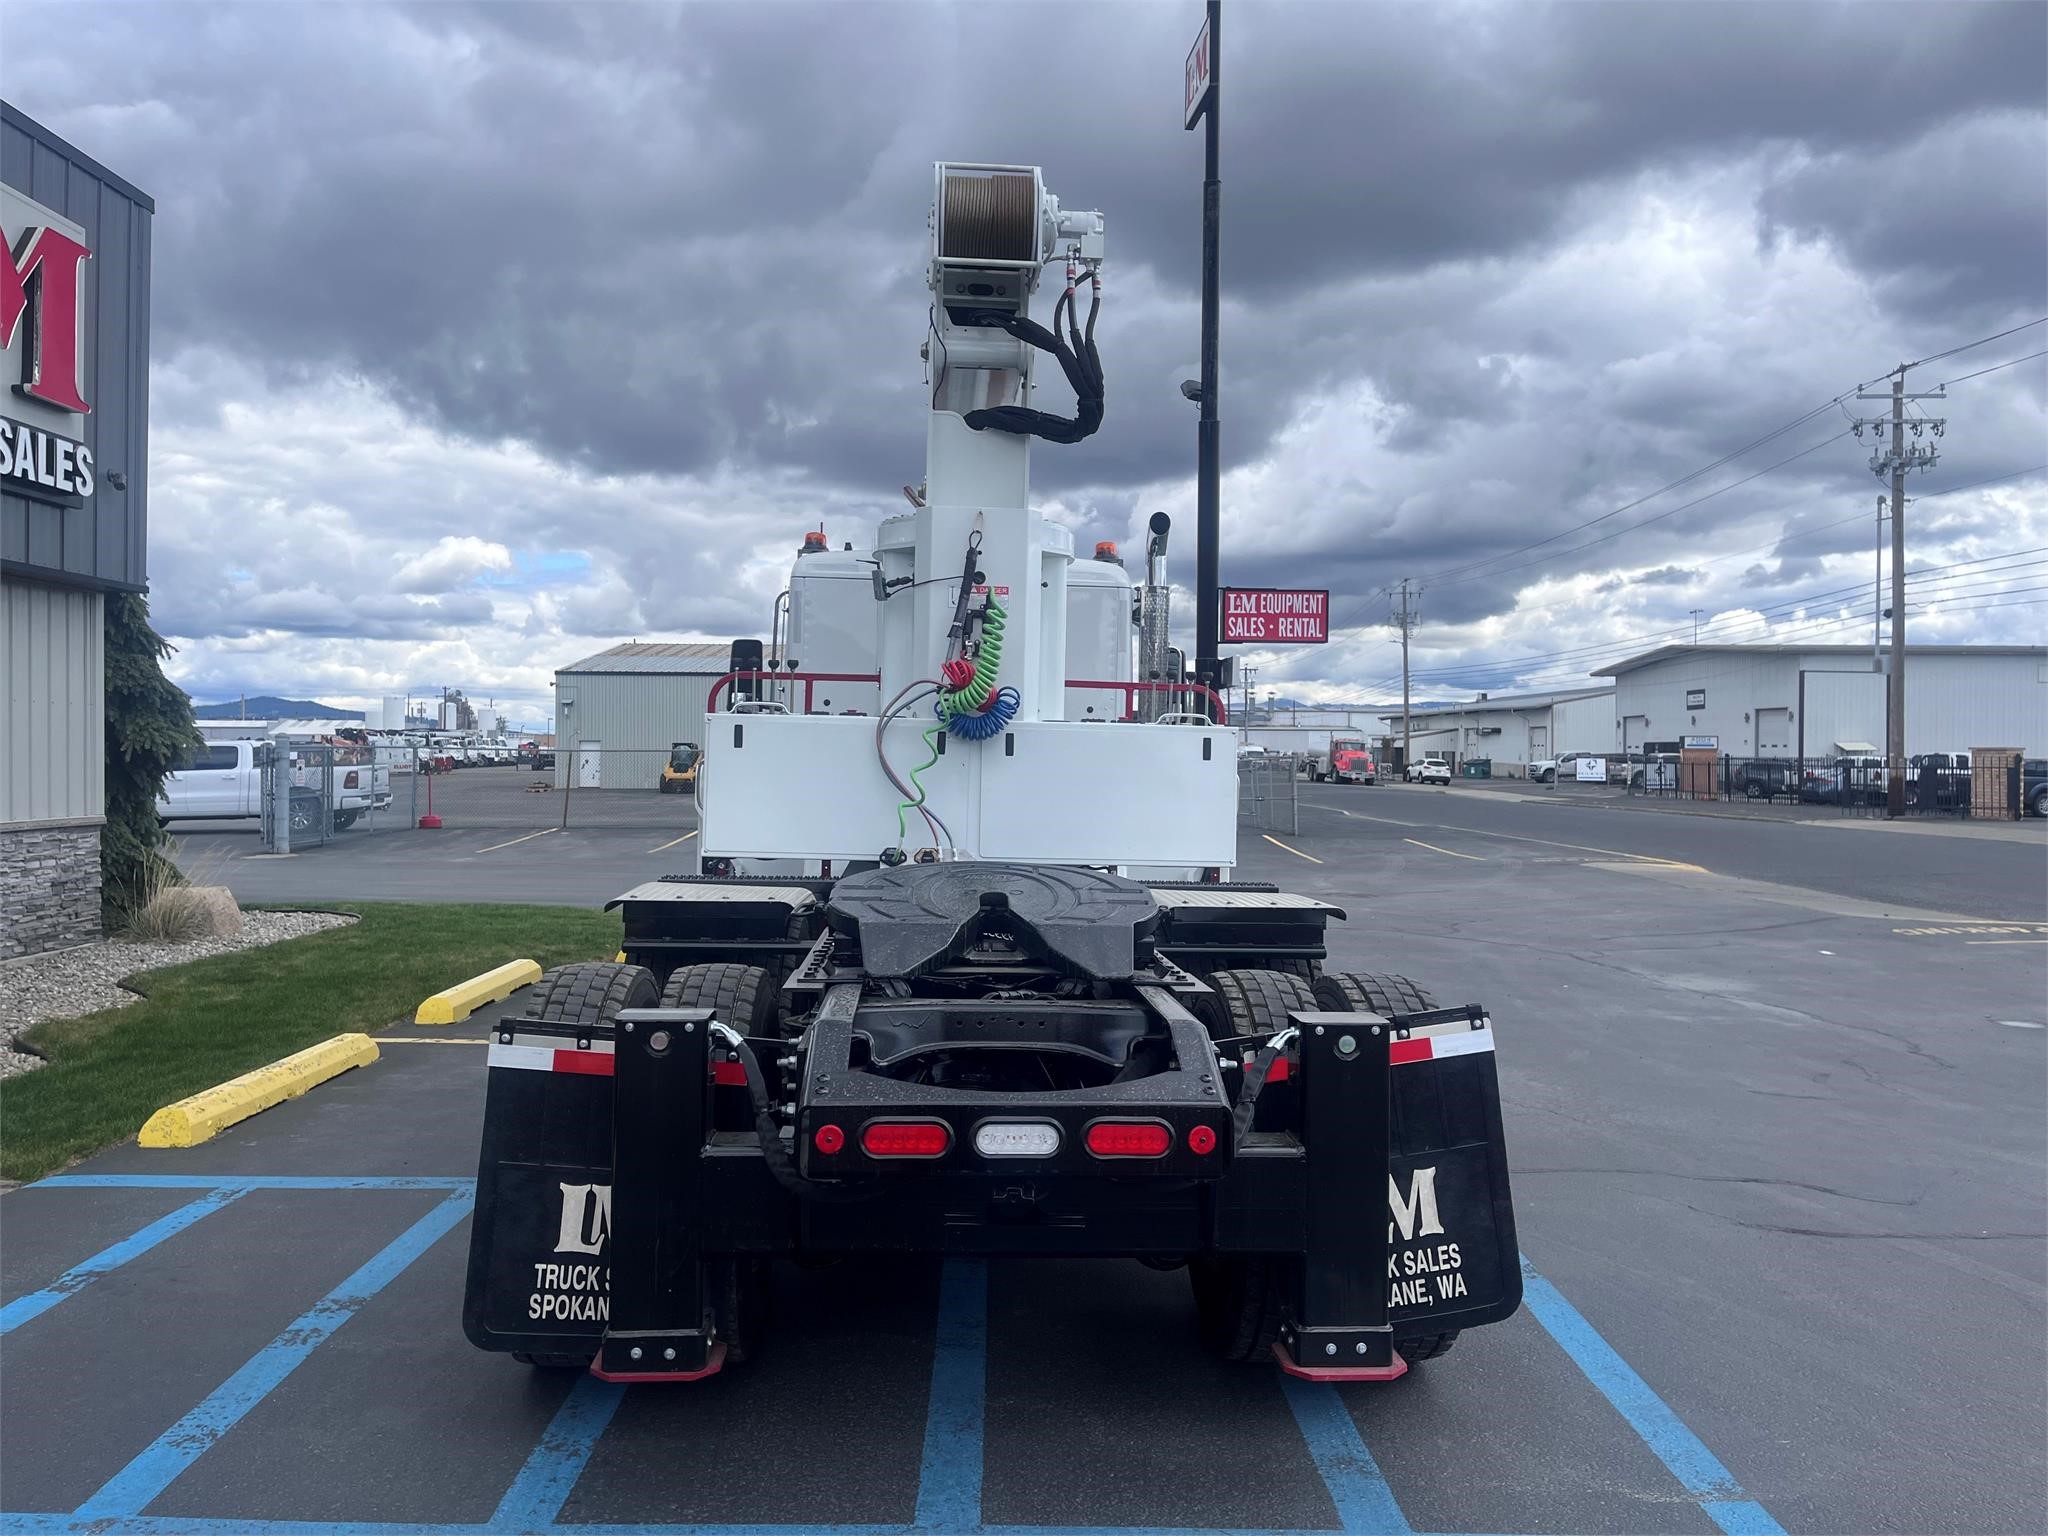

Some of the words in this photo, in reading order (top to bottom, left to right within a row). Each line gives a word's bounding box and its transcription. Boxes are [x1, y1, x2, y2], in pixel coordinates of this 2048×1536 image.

[0, 418, 94, 497] SALES
[1260, 593, 1324, 615] EQUIPMENT
[1228, 616, 1265, 637] SALES
[1278, 617, 1323, 638] RENTAL
[1388, 1166, 1445, 1244] M
[1404, 1243, 1462, 1277] SALES
[534, 1263, 600, 1292] TRUCK
[1388, 1278, 1434, 1308] ANE,
[1436, 1272, 1468, 1300] WA
